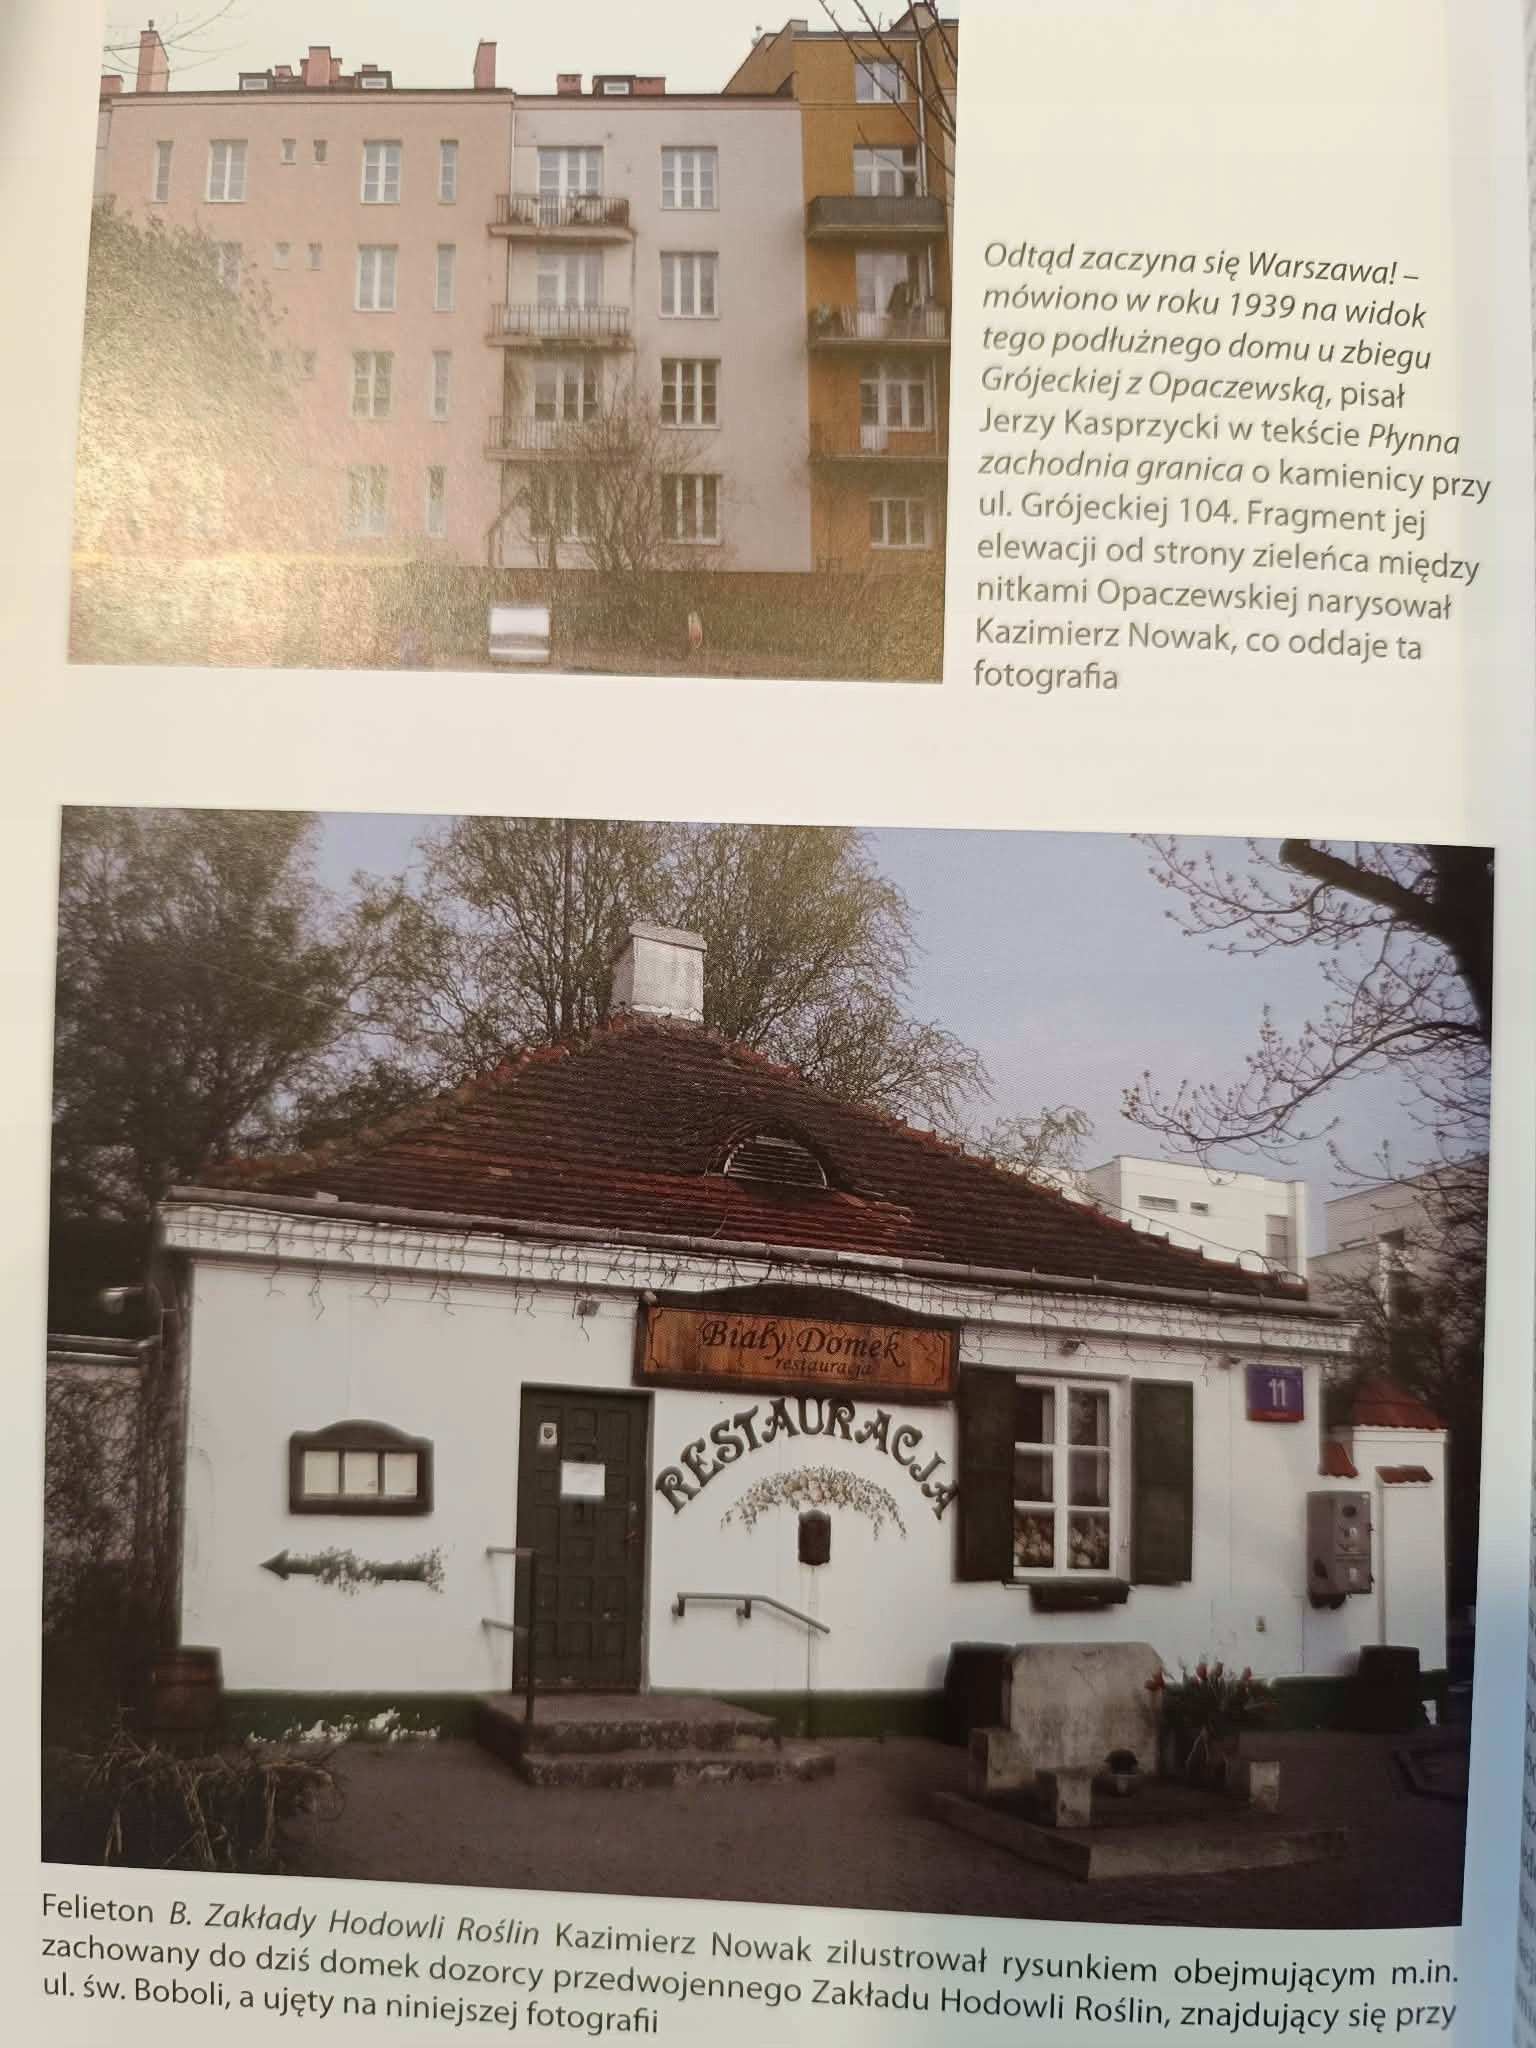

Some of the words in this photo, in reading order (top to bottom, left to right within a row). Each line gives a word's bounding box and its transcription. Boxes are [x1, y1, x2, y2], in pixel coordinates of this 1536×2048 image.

[984, 240, 1076, 276] Odtąd
[1079, 250, 1197, 279] zaczyna
[1202, 249, 1241, 282] się
[1249, 250, 1399, 286] Warszawa!
[982, 283, 1118, 312] mówiono
[1126, 292, 1152, 313] w
[1156, 287, 1220, 316] roku
[1231, 291, 1296, 319] 1939
[1301, 301, 1338, 322] na
[1345, 299, 1428, 329] widok
[983, 327, 1046, 357] tego
[1050, 325, 1222, 363] podłużnego
[1228, 331, 1311, 362] domu
[1317, 343, 1336, 363] u
[1339, 338, 1432, 375] zbiegu
[981, 365, 1122, 401] Grójeckiej
[1125, 375, 1144, 395] z
[1148, 370, 1333, 411] Opaczewską,
[1340, 381, 1406, 412] pisał
[979, 407, 1056, 441] Jerzy
[1064, 407, 1219, 445] Kasprzycki
[1227, 421, 1254, 441] w
[1260, 416, 1360, 447] tekście
[1367, 423, 1461, 457] Płynna
[977, 448, 1129, 479] zachodnia
[1135, 456, 1245, 486] granica
[1251, 464, 1270, 484] o
[1279, 457, 1425, 500] kamienicy
[1432, 475, 1492, 505] przy
[979, 489, 1012, 517] ul.
[1021, 491, 1168, 529] Grójeckiej
[1180, 497, 1238, 525] 104.
[1247, 499, 1387, 535] Fragment
[1391, 507, 1425, 542] jej
[977, 531, 1097, 569] elewacji
[1105, 535, 1144, 563] od
[1153, 541, 1246, 574] strony
[1252, 542, 1369, 573] zieleńca
[1378, 550, 1481, 587] między
[977, 575, 1088, 604] nitkami
[1096, 578, 1298, 619] Opaczewskiej
[1307, 592, 1453, 622] narysował
[975, 616, 1121, 648] Kazimierz
[1128, 621, 1238, 656] Nowak,
[1245, 632, 1280, 653] co
[1288, 627, 1388, 665] oddaje
[1395, 636, 1423, 661] ta
[973, 658, 1118, 695] fotografia
[702, 1318, 786, 1361] Biały
[797, 1325, 906, 1369] Domek
[776, 1357, 874, 1379] restauraja
[1267, 1377, 1287, 1407] 11
[655, 1396, 958, 1520] RESTAURACJA
[42, 1892, 154, 1924] Felieton
[168, 1900, 192, 1927] B.
[203, 1902, 318, 1940] Zakłady
[328, 1908, 446, 1940] Hodowli
[456, 1916, 540, 1946] Roślin
[555, 1922, 696, 1955] Kazimierz
[711, 1931, 813, 1963] Nowak
[826, 1938, 988, 1974] zilustrował
[1002, 1952, 1157, 1984] rysunkiem
[1173, 1957, 1375, 1995] obejmującym
[1391, 1958, 1459, 1985] m.in.
[41, 1933, 201, 1973] zachowany
[208, 1941, 247, 1969] do
[255, 1944, 310, 1973] dziś
[319, 1947, 421, 1979] domek
[428, 1954, 545, 1993] dozorcy
[553, 1965, 802, 2008] przedwojennego
[810, 1978, 929, 2012] Zakładu
[940, 1986, 1064, 2020] Hodowli
[1075, 1995, 1171, 2029] Roślin,
[1179, 2000, 1340, 2036] znajdujący
[1347, 2001, 1387, 2034] się
[1395, 2004, 1457, 2033] przy
[43, 1970, 75, 1998] ul.
[82, 1973, 126, 2001] św.
[135, 1977, 231, 2011] Boboli,
[239, 1990, 254, 2009] a
[263, 1986, 335, 2020] ujęty
[343, 1995, 377, 2016] na
[386, 1993, 518, 2031] niniejszej
[526, 1999, 658, 2037] fotografii
